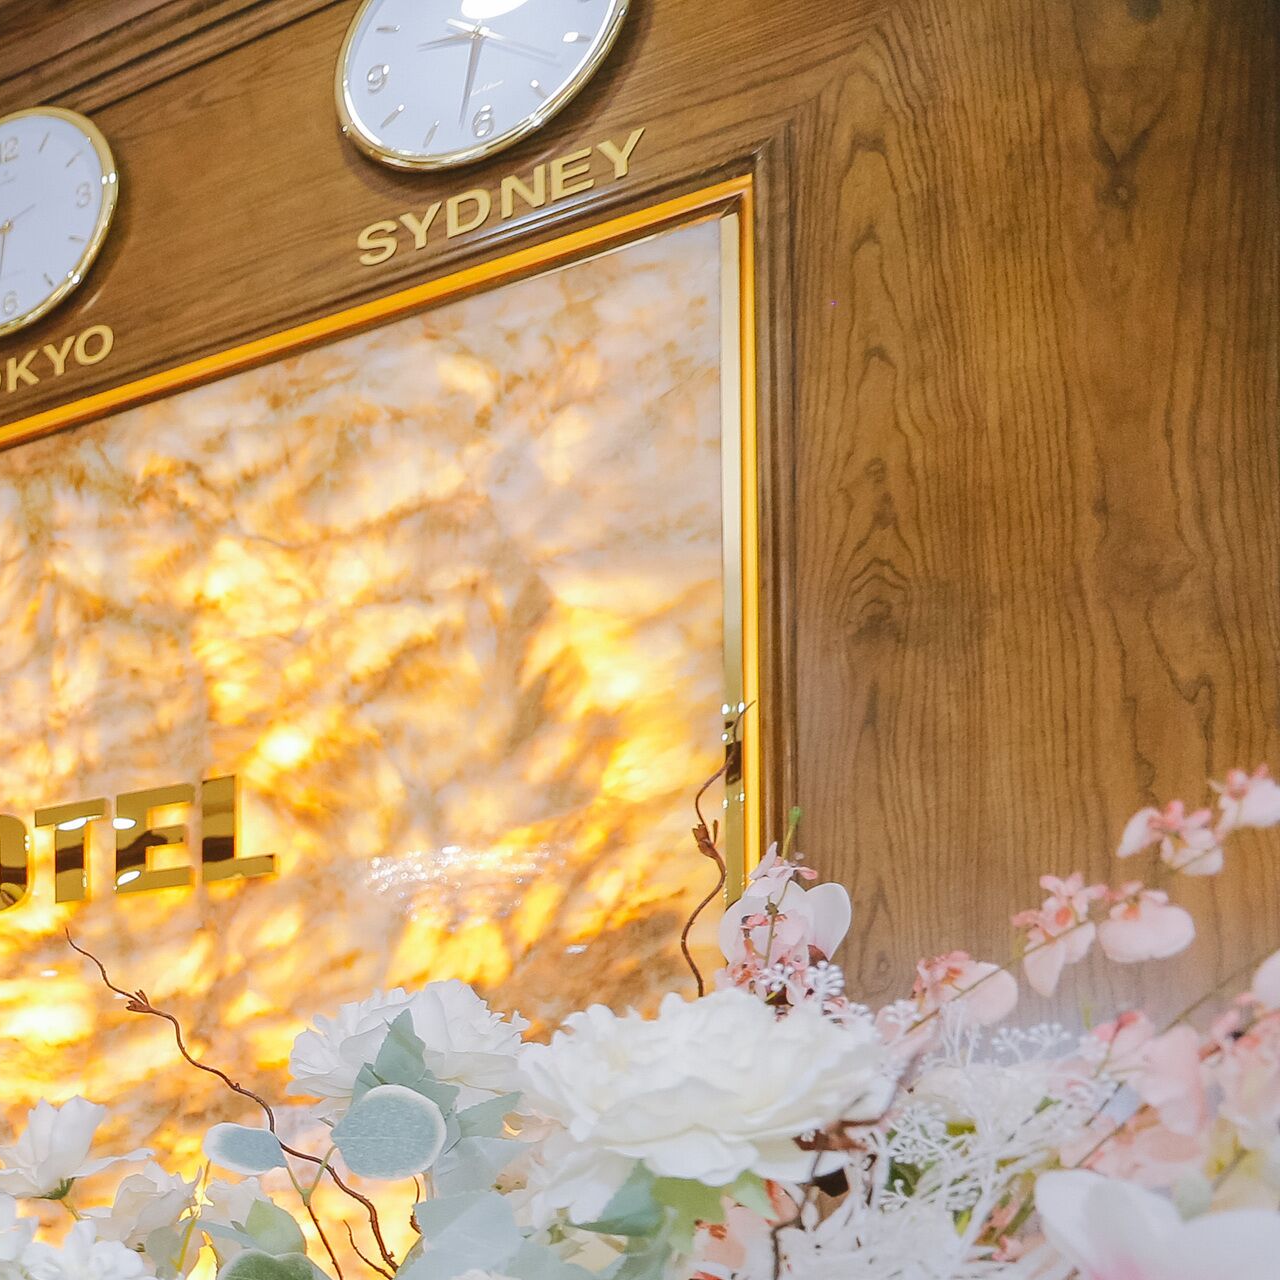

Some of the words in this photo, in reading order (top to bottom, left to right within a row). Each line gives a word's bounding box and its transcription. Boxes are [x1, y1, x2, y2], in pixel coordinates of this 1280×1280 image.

[367, 64, 390, 94] 9
[472, 104, 495, 138] 6
[75, 181, 92, 209] 3
[356, 127, 646, 267] SYDNEY
[1, 289, 19, 316] 6
